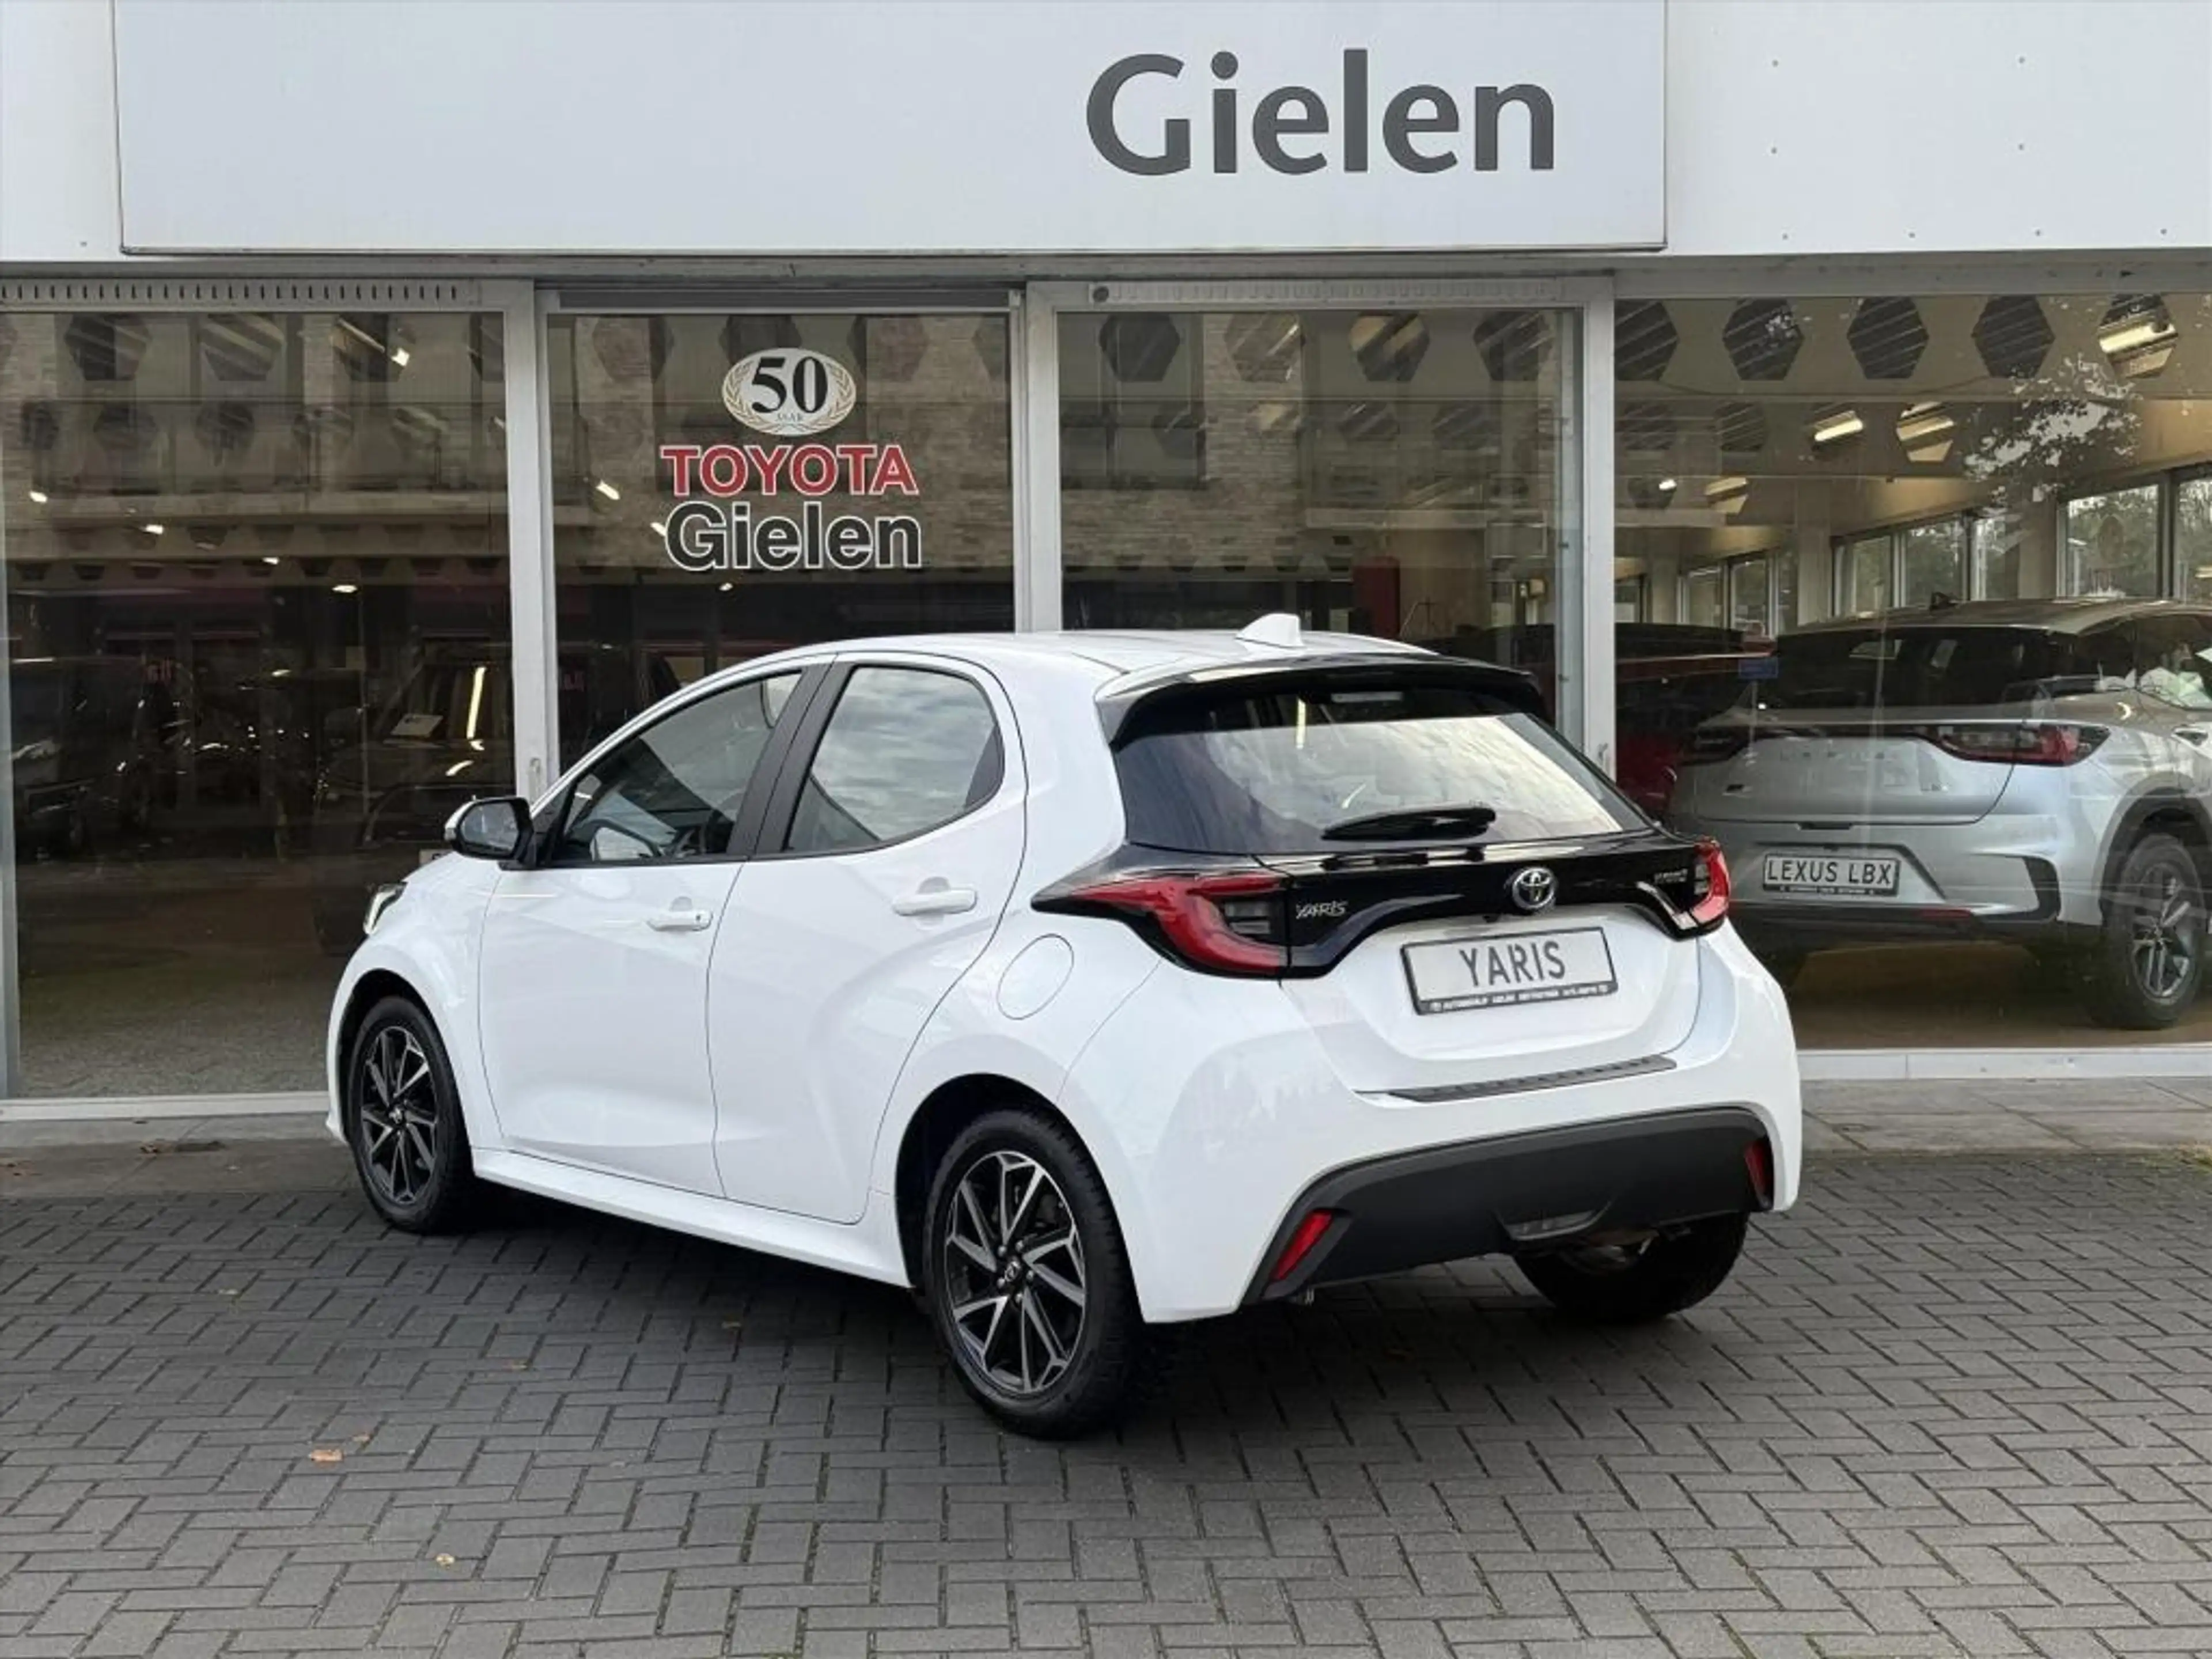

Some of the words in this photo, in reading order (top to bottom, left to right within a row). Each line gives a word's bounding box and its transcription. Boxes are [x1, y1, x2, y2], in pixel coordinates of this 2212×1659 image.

[1086, 48, 1554, 176] Gielen
[751, 356, 828, 413] 50
[660, 445, 919, 496] TOYOTA
[665, 501, 922, 571] Gielen
[1767, 861, 1839, 882] LEXUS
[1849, 863, 1891, 884] LBX
[1296, 900, 1348, 919] YARIS
[1459, 941, 1566, 987] YARIS
